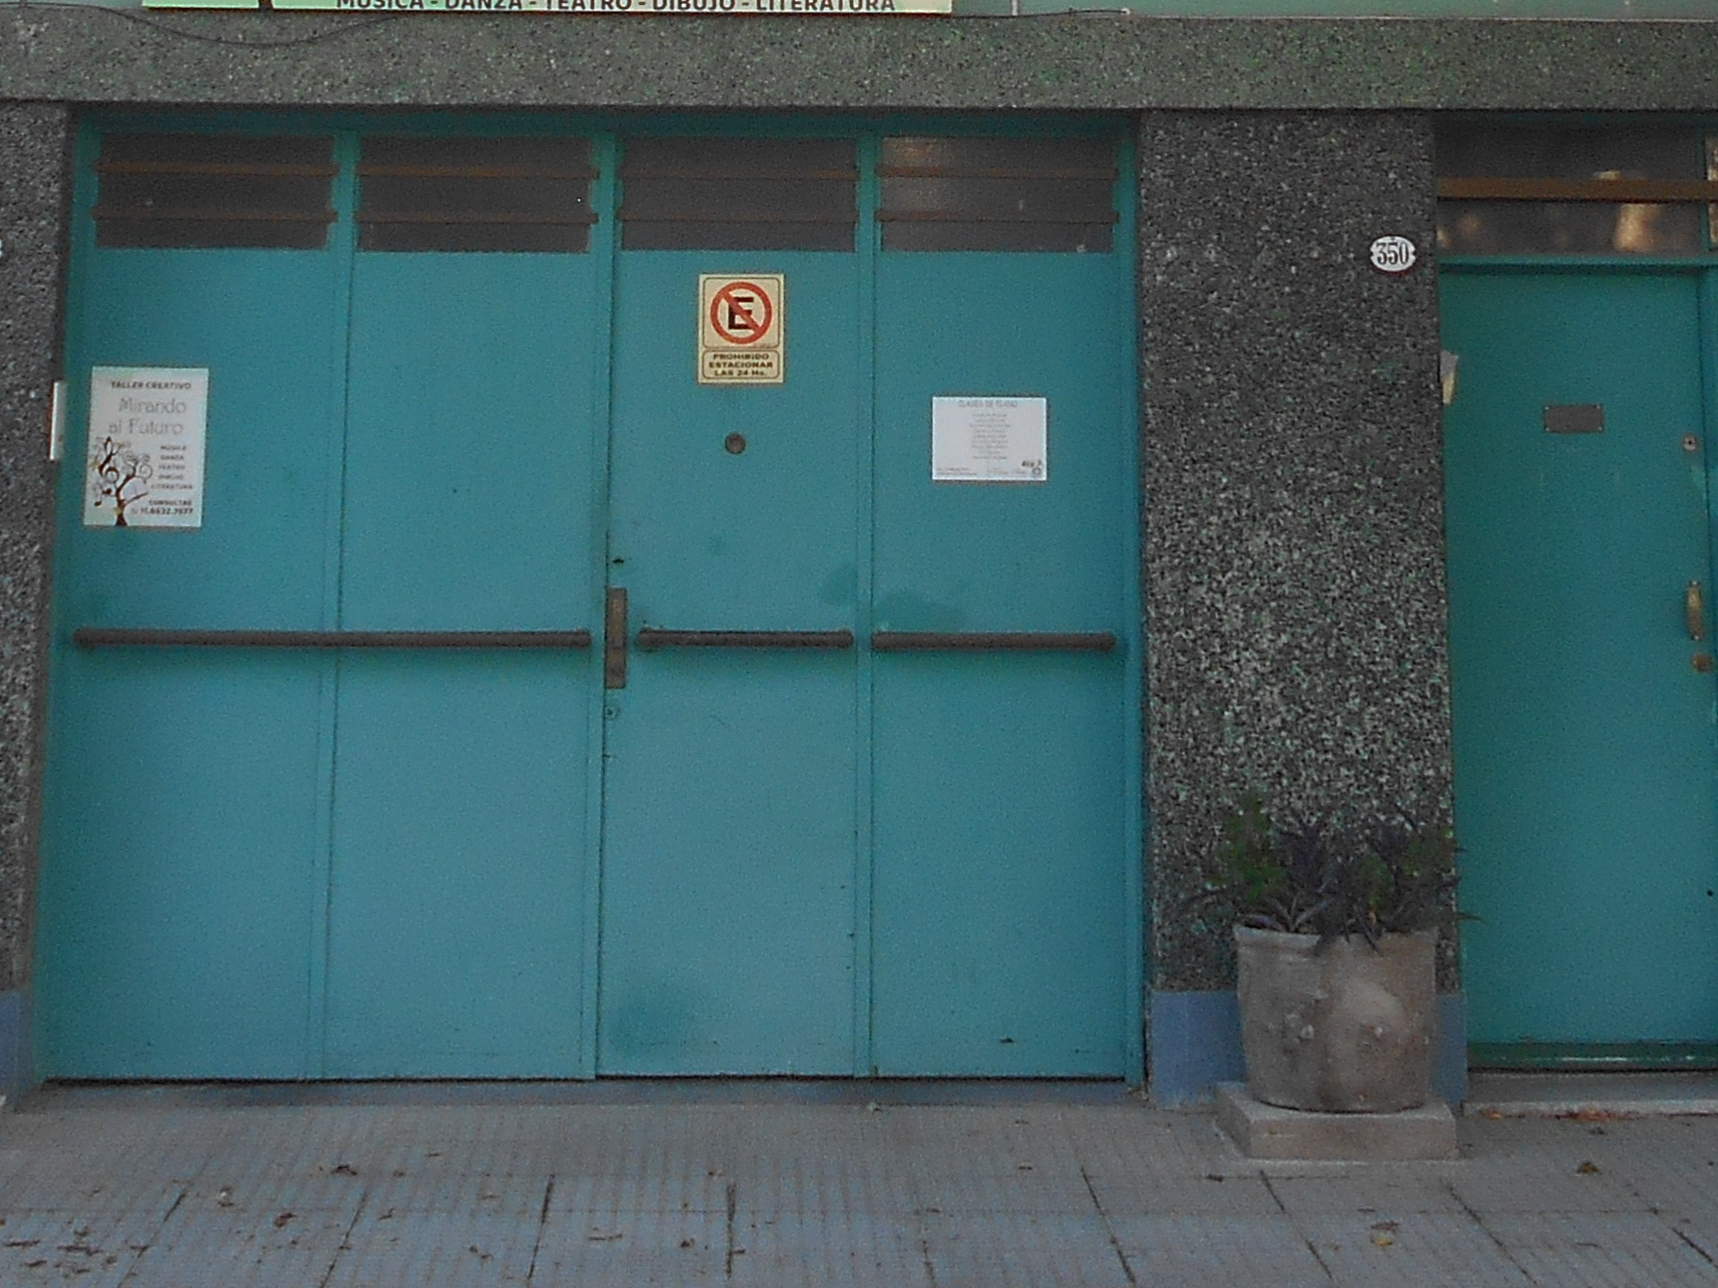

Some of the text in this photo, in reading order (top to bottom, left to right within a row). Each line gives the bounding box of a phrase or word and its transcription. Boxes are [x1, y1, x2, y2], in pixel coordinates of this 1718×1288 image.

[1376, 242, 1409, 265] 350
[728, 296, 754, 330] E
[708, 361, 773, 369] ESTACIONAR
[714, 369, 734, 377] LAS
[737, 369, 749, 377] 24
[111, 381, 192, 390] TALLER CREATIVO
[118, 396, 187, 414] Mirando
[108, 417, 184, 435] al Futuro
